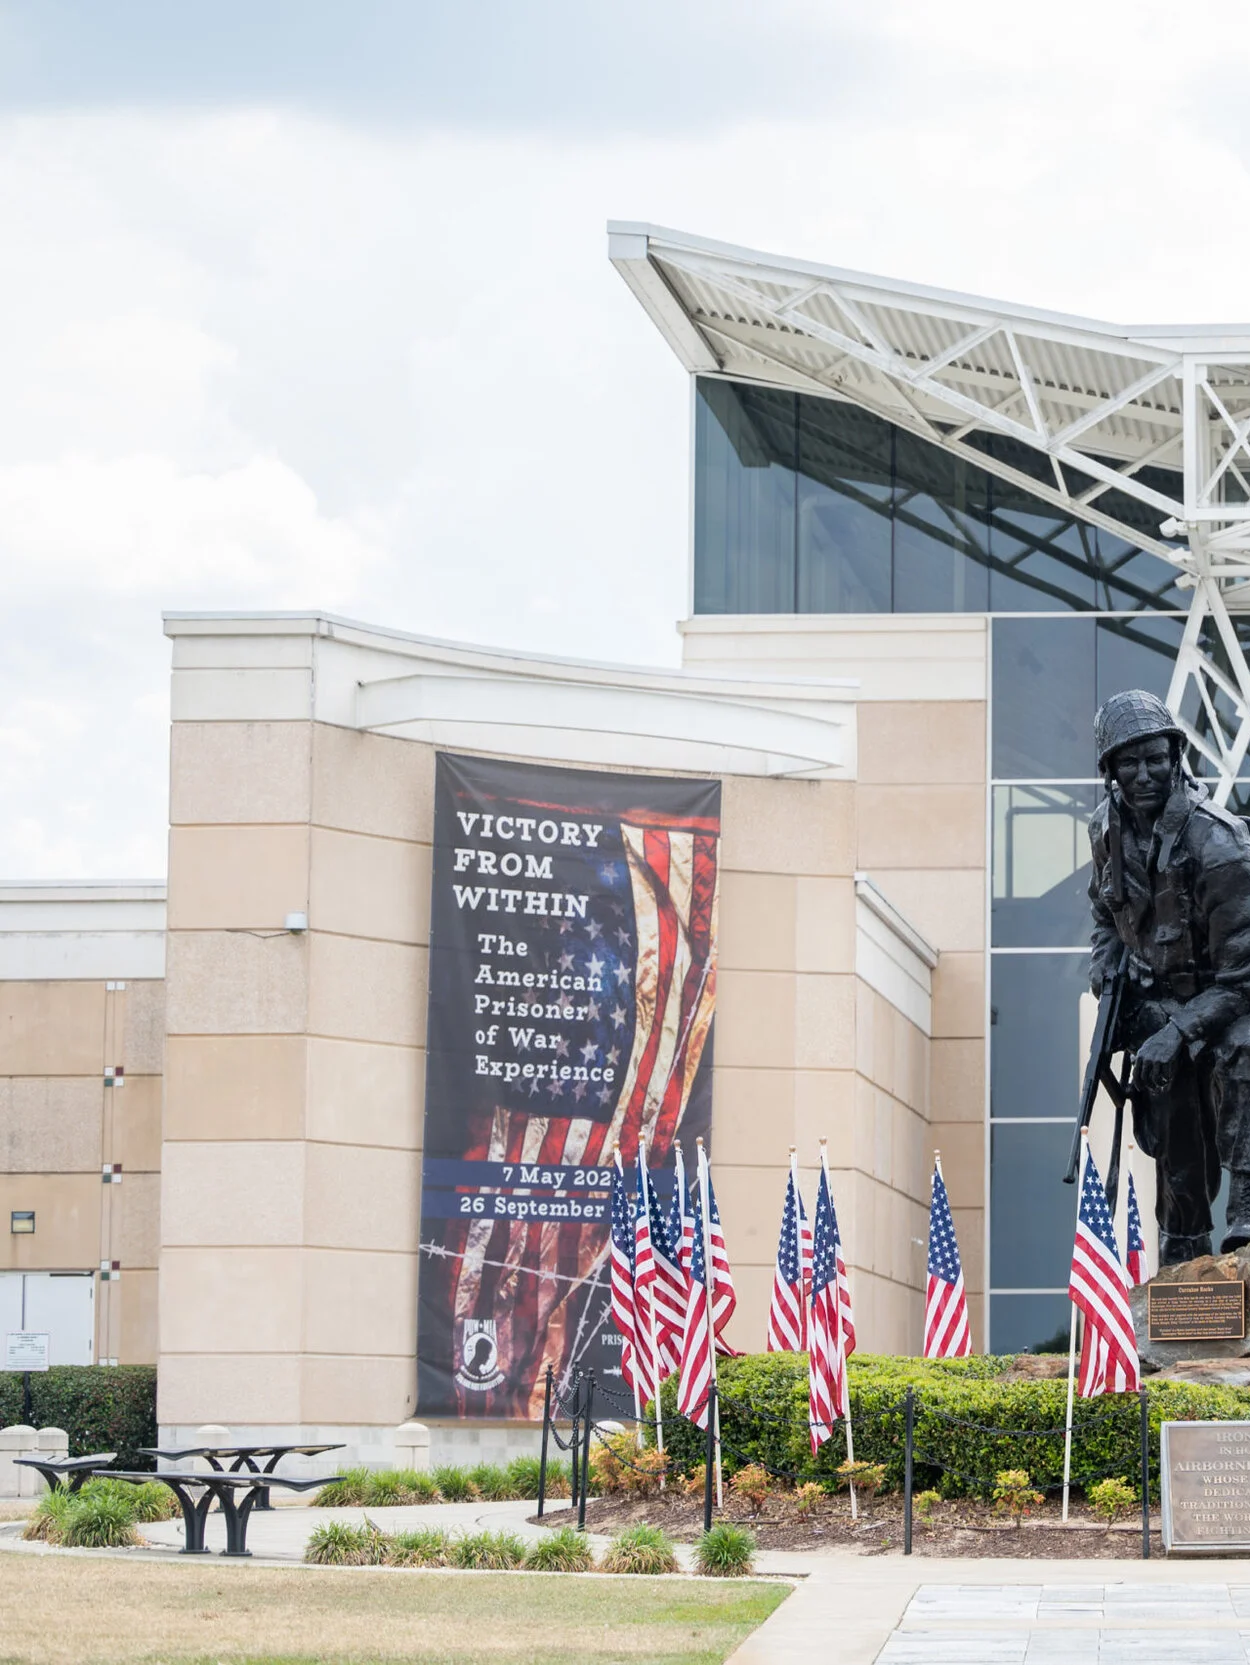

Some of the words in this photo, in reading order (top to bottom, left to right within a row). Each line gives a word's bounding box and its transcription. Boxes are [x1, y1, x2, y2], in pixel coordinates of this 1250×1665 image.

[456, 811, 603, 848] VICTORY
[453, 848, 553, 880] FROM
[452, 885, 589, 918] WITHIN
[478, 933, 528, 957] The
[474, 965, 603, 992] American
[474, 995, 589, 1021] Prisoner
[475, 1025, 499, 1045] of
[508, 1028, 561, 1049] War
[475, 1055, 615, 1082] Experience
[502, 1167, 513, 1181] 7
[520, 1166, 566, 1189] May
[574, 1170, 611, 1187] 202
[460, 1197, 485, 1213] 26
[494, 1198, 605, 1219] September
[1219, 1446, 1232, 1455] IN
[1203, 1475, 1248, 1484] WHOSE
[1193, 1513, 1220, 1522] THE
